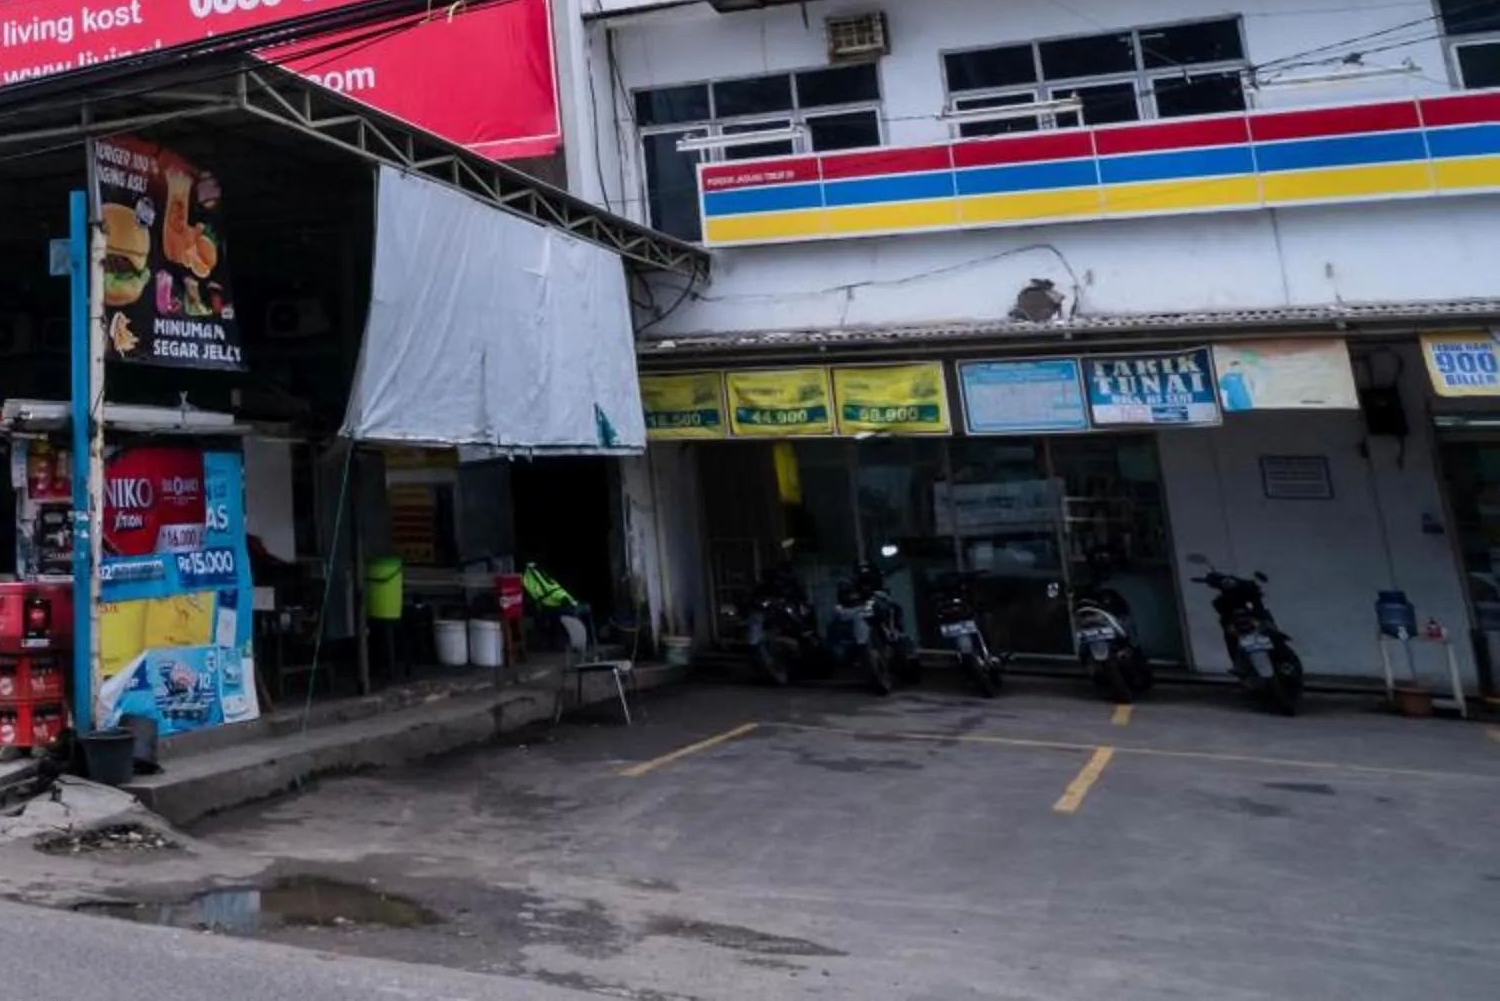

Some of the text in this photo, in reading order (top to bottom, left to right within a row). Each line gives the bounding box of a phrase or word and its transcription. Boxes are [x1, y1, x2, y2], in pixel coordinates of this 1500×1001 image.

[3, 15, 74, 48] living
[153, 318, 226, 341] MINUMAN
[152, 339, 200, 359] SEGAR
[1093, 353, 1200, 378] TARIK
[1435, 352, 1497, 373] 900
[1092, 373, 1205, 397] TUNAI
